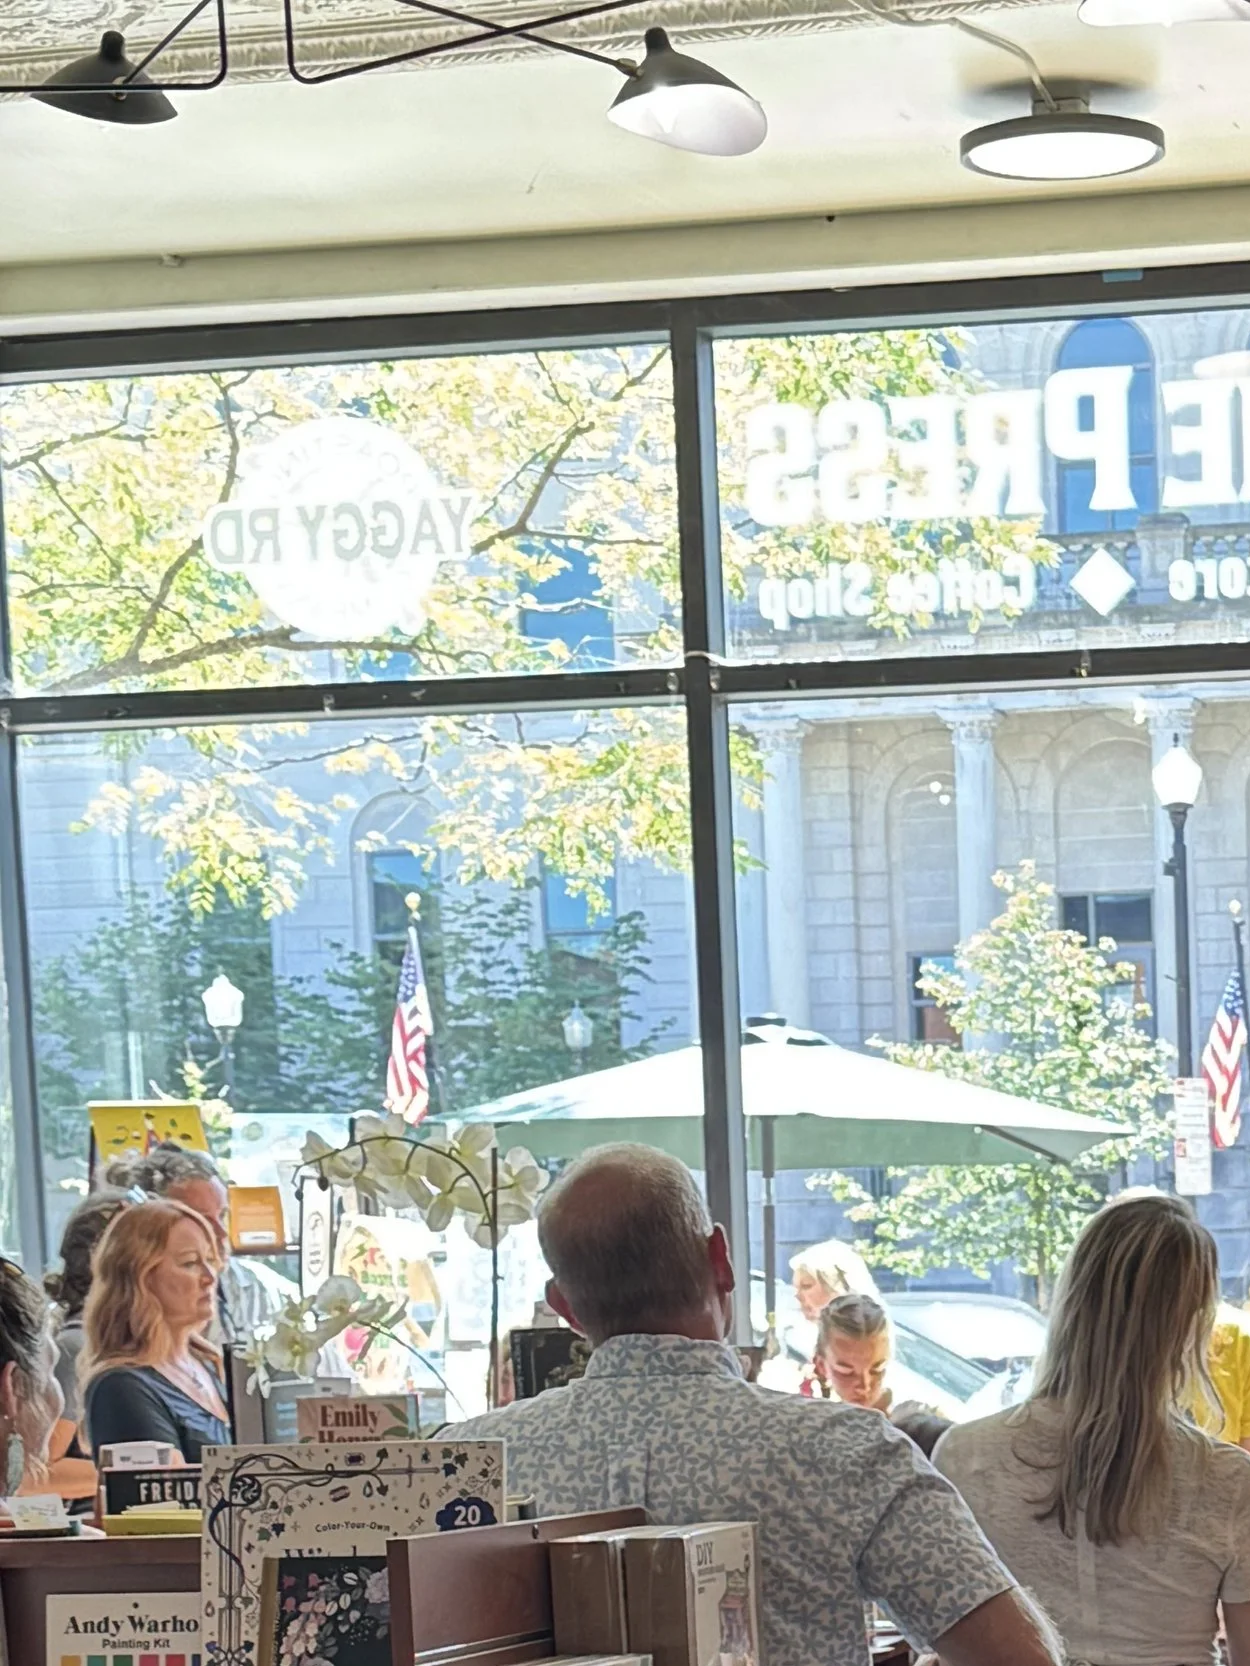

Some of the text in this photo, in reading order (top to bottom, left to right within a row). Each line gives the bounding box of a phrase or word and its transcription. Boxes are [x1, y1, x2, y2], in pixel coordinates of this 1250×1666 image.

[320, 1403, 381, 1434] Emily
[140, 1481, 202, 1503] FREID
[315, 1521, 391, 1533] Color-Your-Own
[453, 1505, 481, 1527] 20
[696, 1541, 713, 1567] DIY
[64, 1614, 199, 1637] Andy Warho
[102, 1638, 170, 1650] Painting Kit
